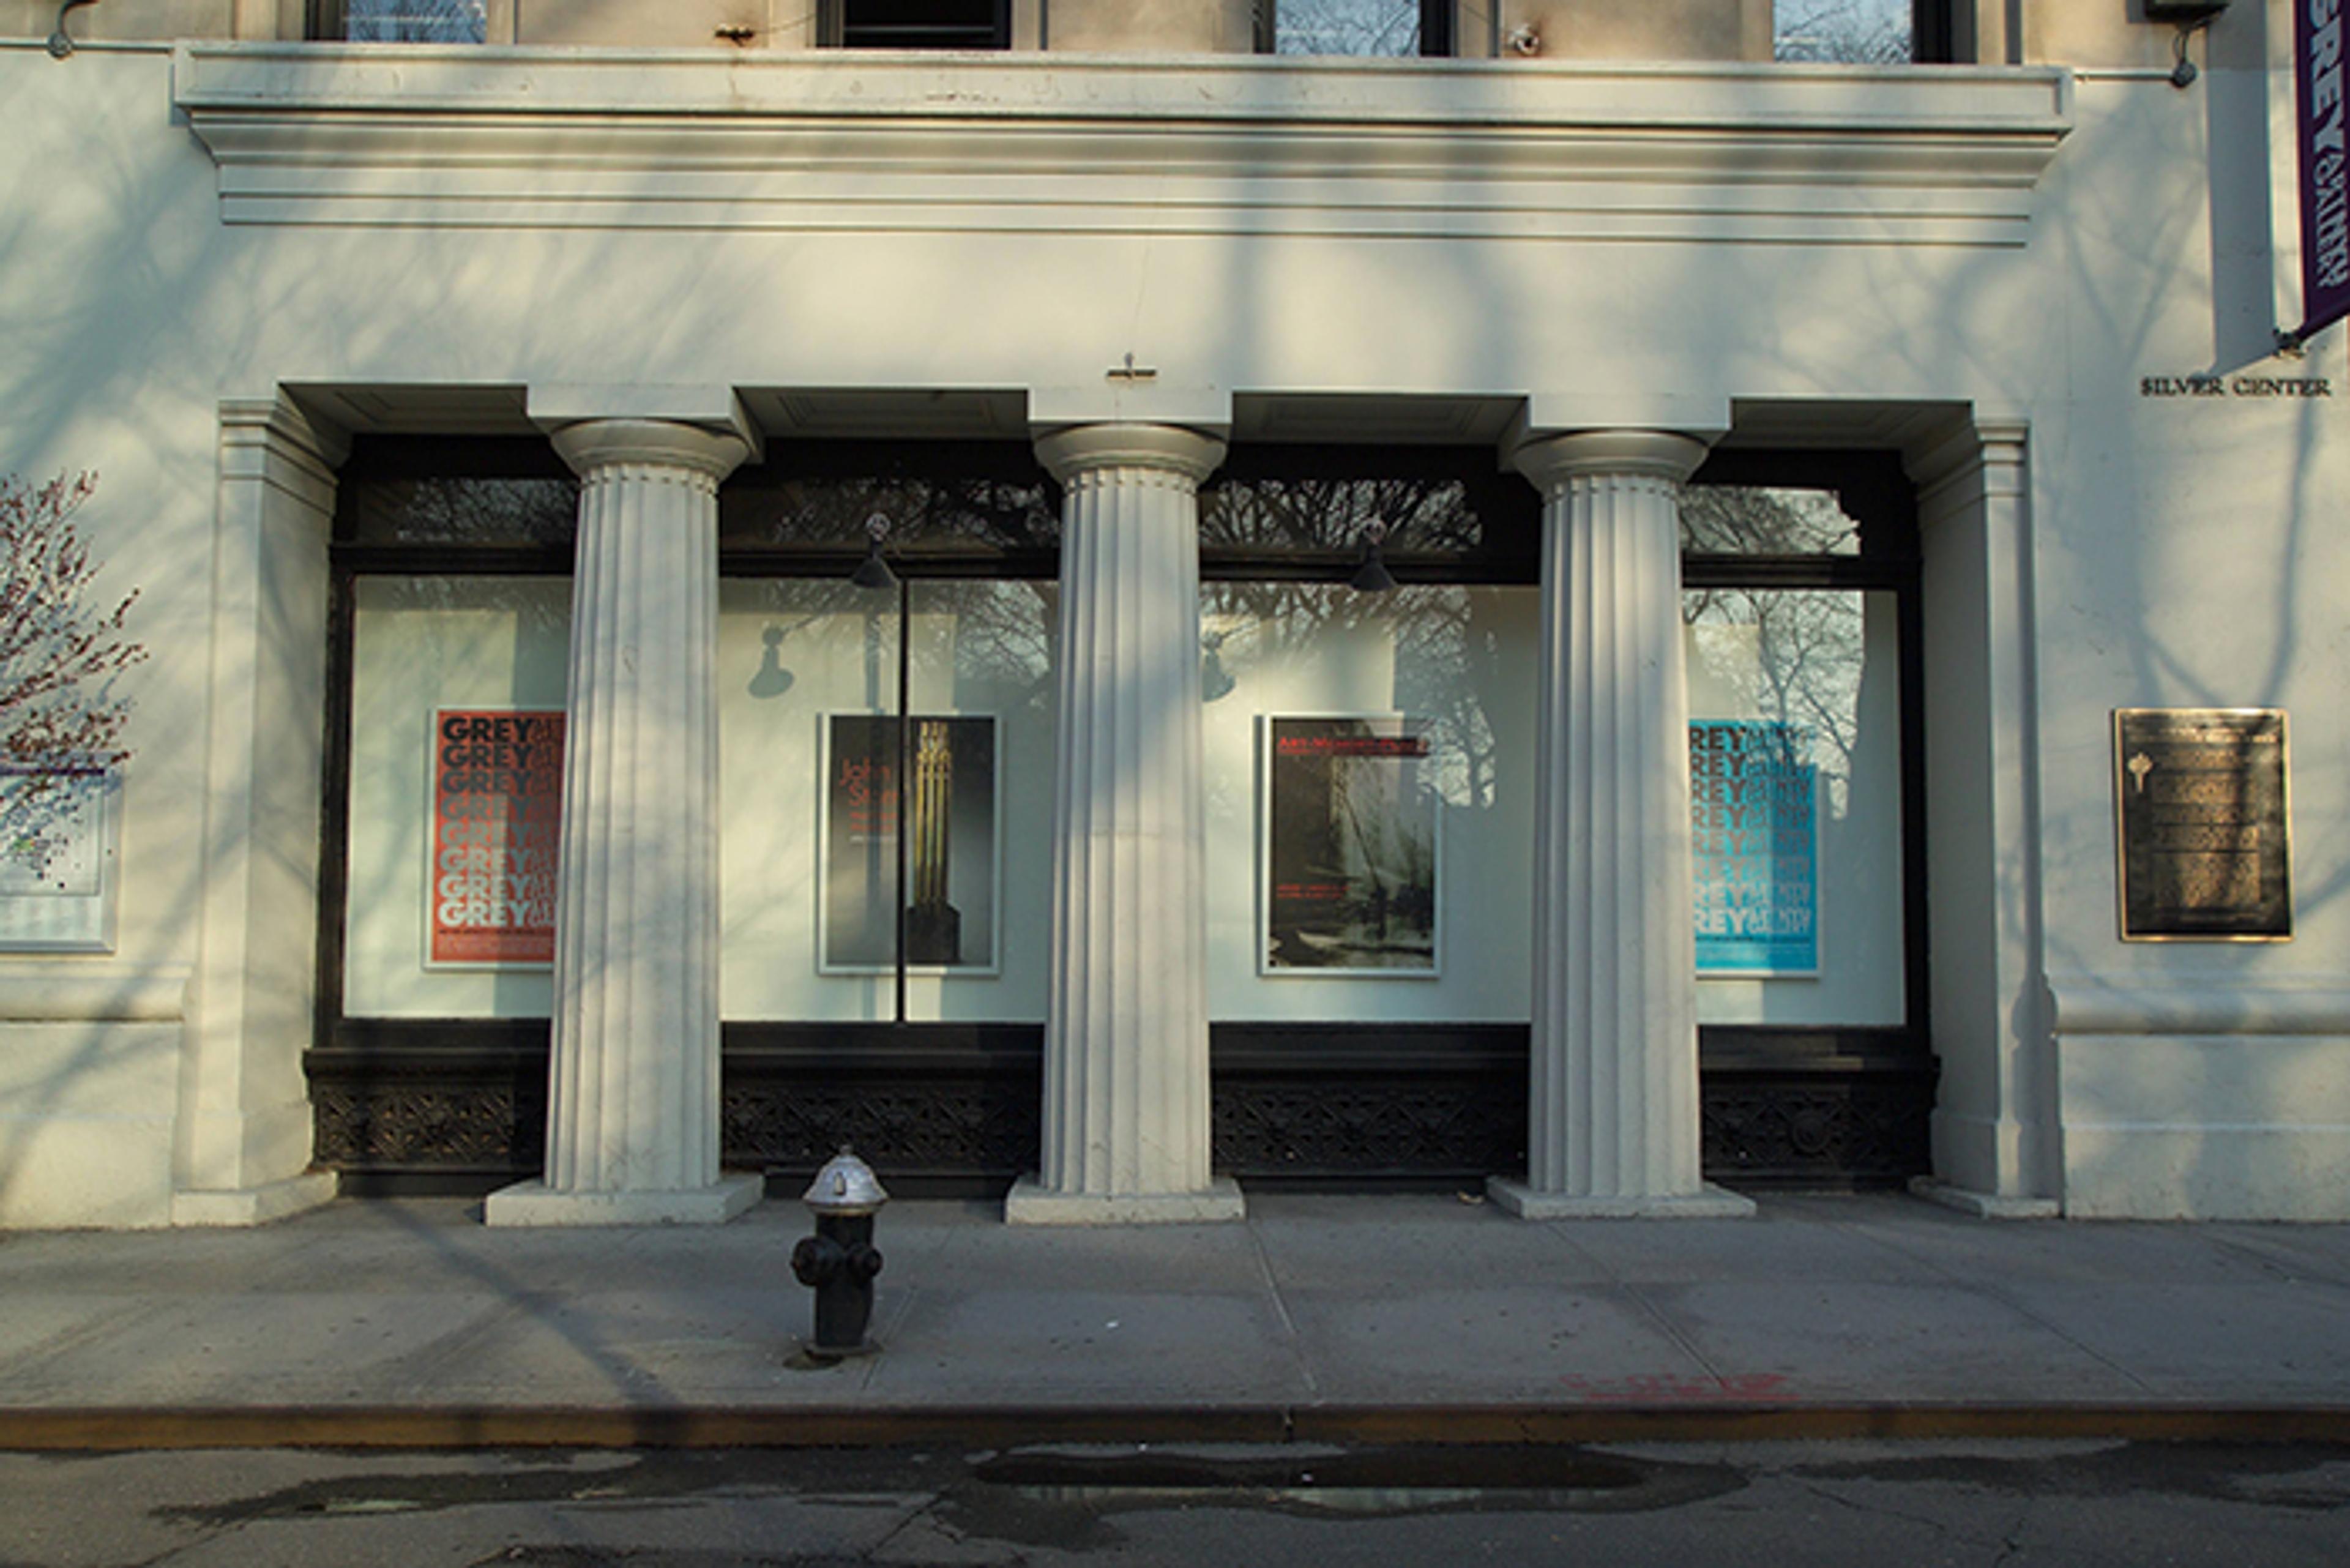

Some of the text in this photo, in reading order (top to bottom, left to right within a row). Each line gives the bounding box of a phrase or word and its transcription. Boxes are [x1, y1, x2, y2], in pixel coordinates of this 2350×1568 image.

[2141, 376, 2332, 397] SILVER CENTER
[442, 717, 533, 742] GREY
[1688, 726, 1747, 750] REY
[442, 745, 532, 768] GREY
[1689, 753, 1747, 777] REY
[441, 771, 531, 795] GREY
[1691, 779, 1747, 803] REY
[441, 796, 531, 821] GREY
[1692, 805, 1747, 829] REY
[1692, 831, 1747, 855] REY
[439, 848, 530, 873] GREY
[439, 875, 530, 899] GREY
[1693, 883, 1747, 907] REY
[438, 901, 529, 927] GREY
[1694, 909, 1747, 934] REY
